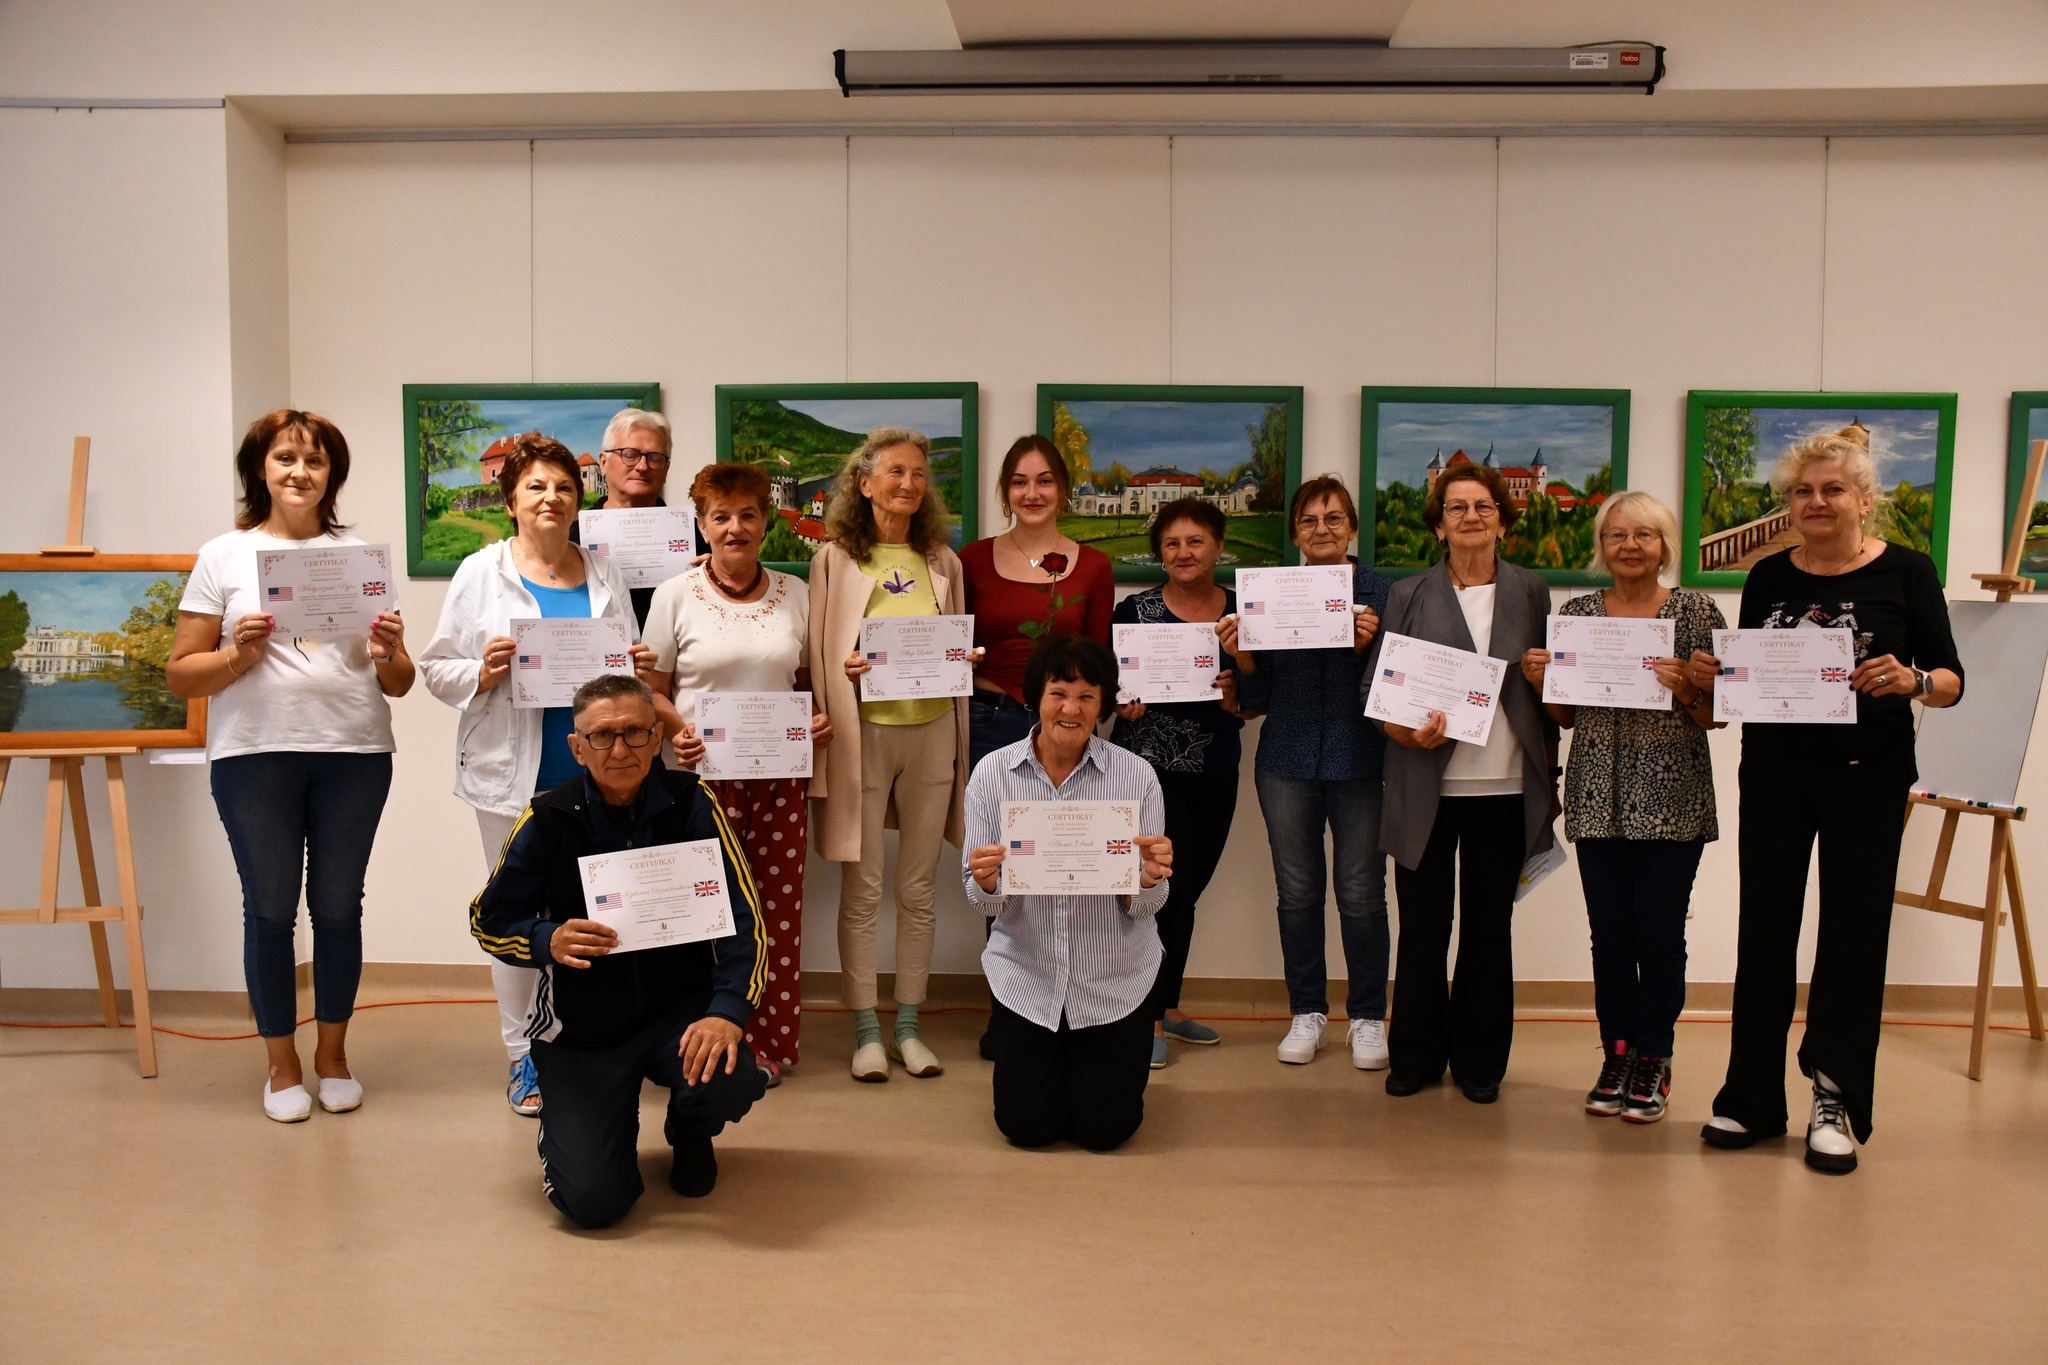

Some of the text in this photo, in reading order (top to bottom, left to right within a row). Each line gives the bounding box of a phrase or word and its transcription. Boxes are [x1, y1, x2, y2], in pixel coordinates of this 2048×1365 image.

[618, 518, 657, 526] CERTYFIKAT
[303, 558, 349, 568] CERTYFIKAT
[1275, 577, 1314, 585] CERTYFIKAT
[898, 626, 937, 634] CERTYFIKAT
[1588, 628, 1632, 637] CERTYFIKAT
[1422, 653, 1465, 669] CERTYFIKAT
[736, 703, 776, 711] CERTYFIKAT
[1047, 813, 1094, 821] CERTYFIKAT
[629, 857, 678, 870] CERTYFIKAT
